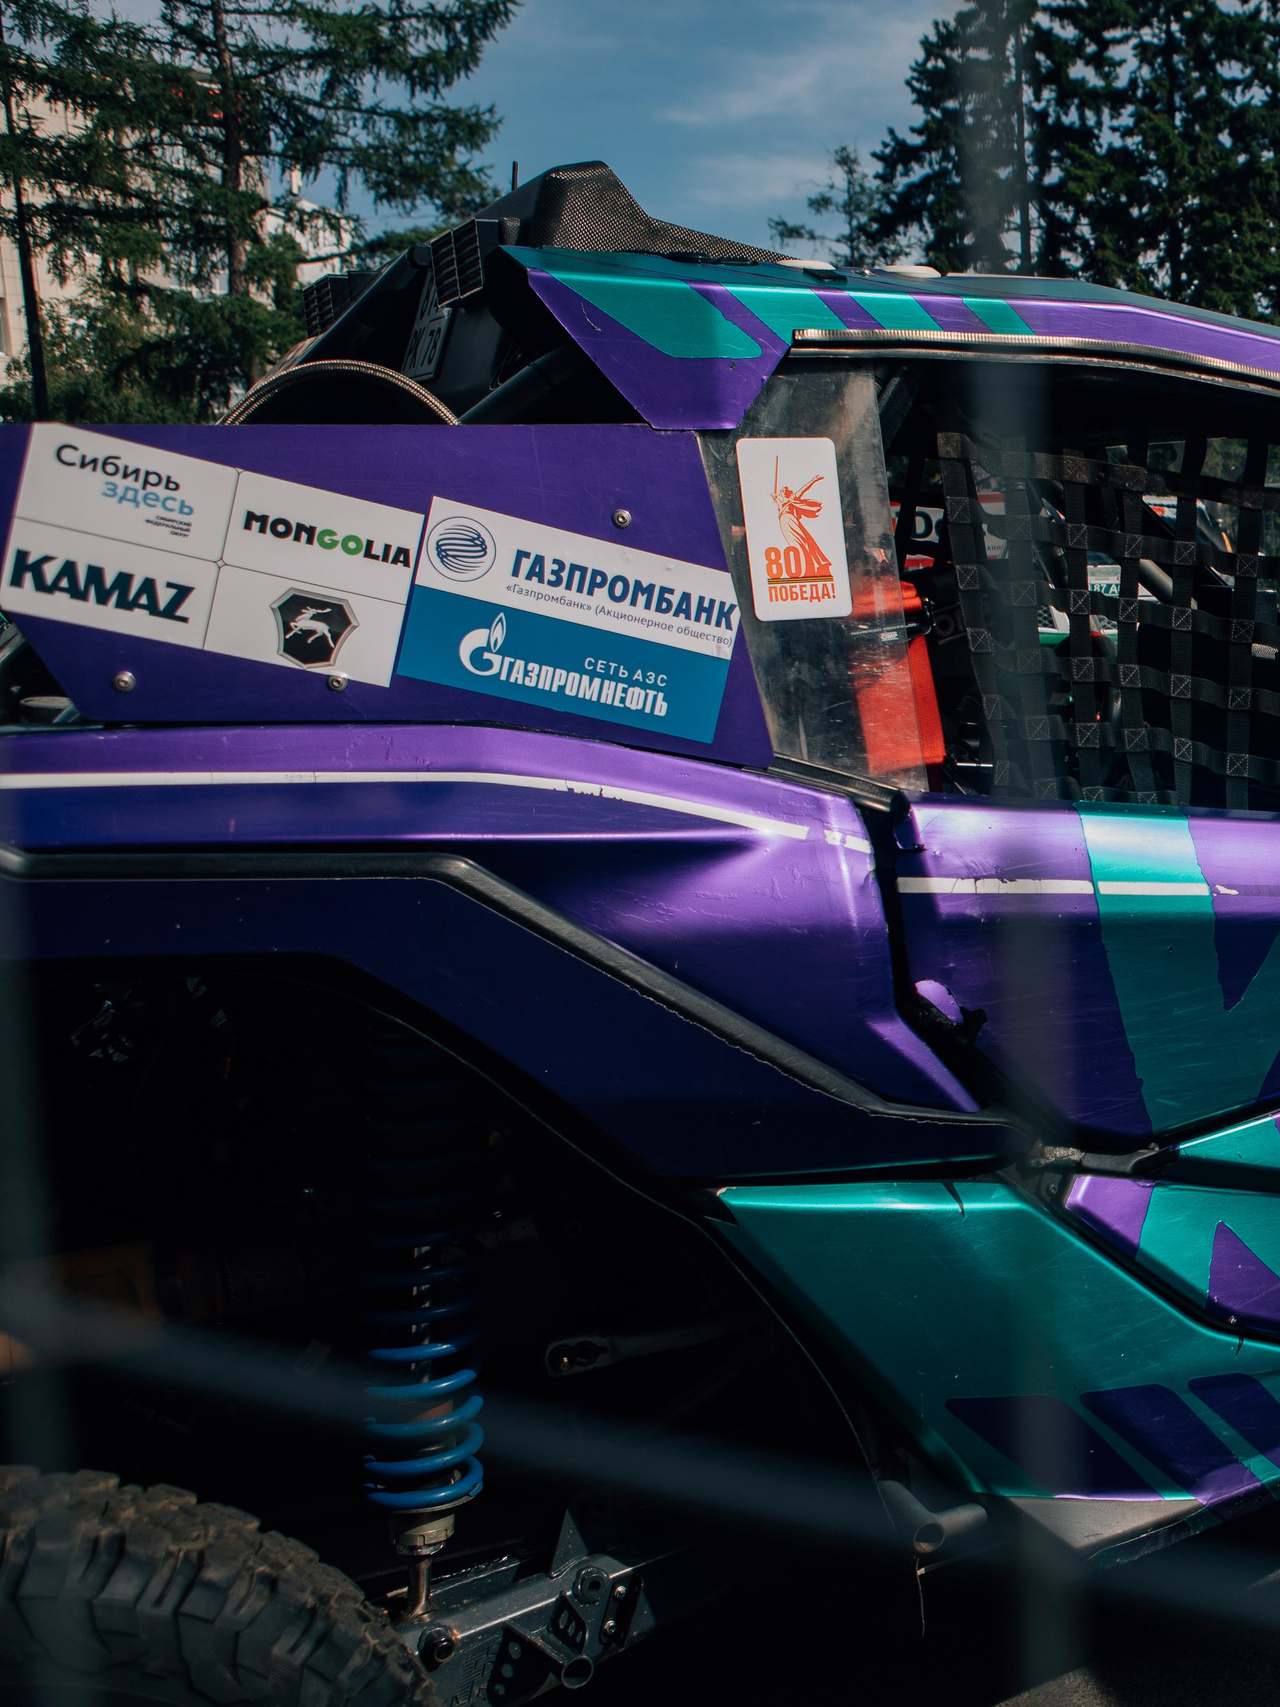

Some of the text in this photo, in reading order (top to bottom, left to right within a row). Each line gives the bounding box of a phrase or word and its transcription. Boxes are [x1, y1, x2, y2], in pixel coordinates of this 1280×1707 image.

[55, 444, 181, 491] Сибирь
[101, 482, 195, 516] здесь
[243, 510, 412, 568] MONGOLIA
[764, 546, 801, 579] 80
[9, 549, 197, 624] KAMAZ
[510, 549, 738, 631] ГАЗПРОМБАНК
[768, 583, 837, 603] ПОБЕДА!
[506, 583, 734, 648] «Газпромбанк» (Акционерное общество)
[500, 655, 668, 717] ГАЗПРОМНЕФТЬ
[585, 657, 668, 687] СЕТЬ АЗС
